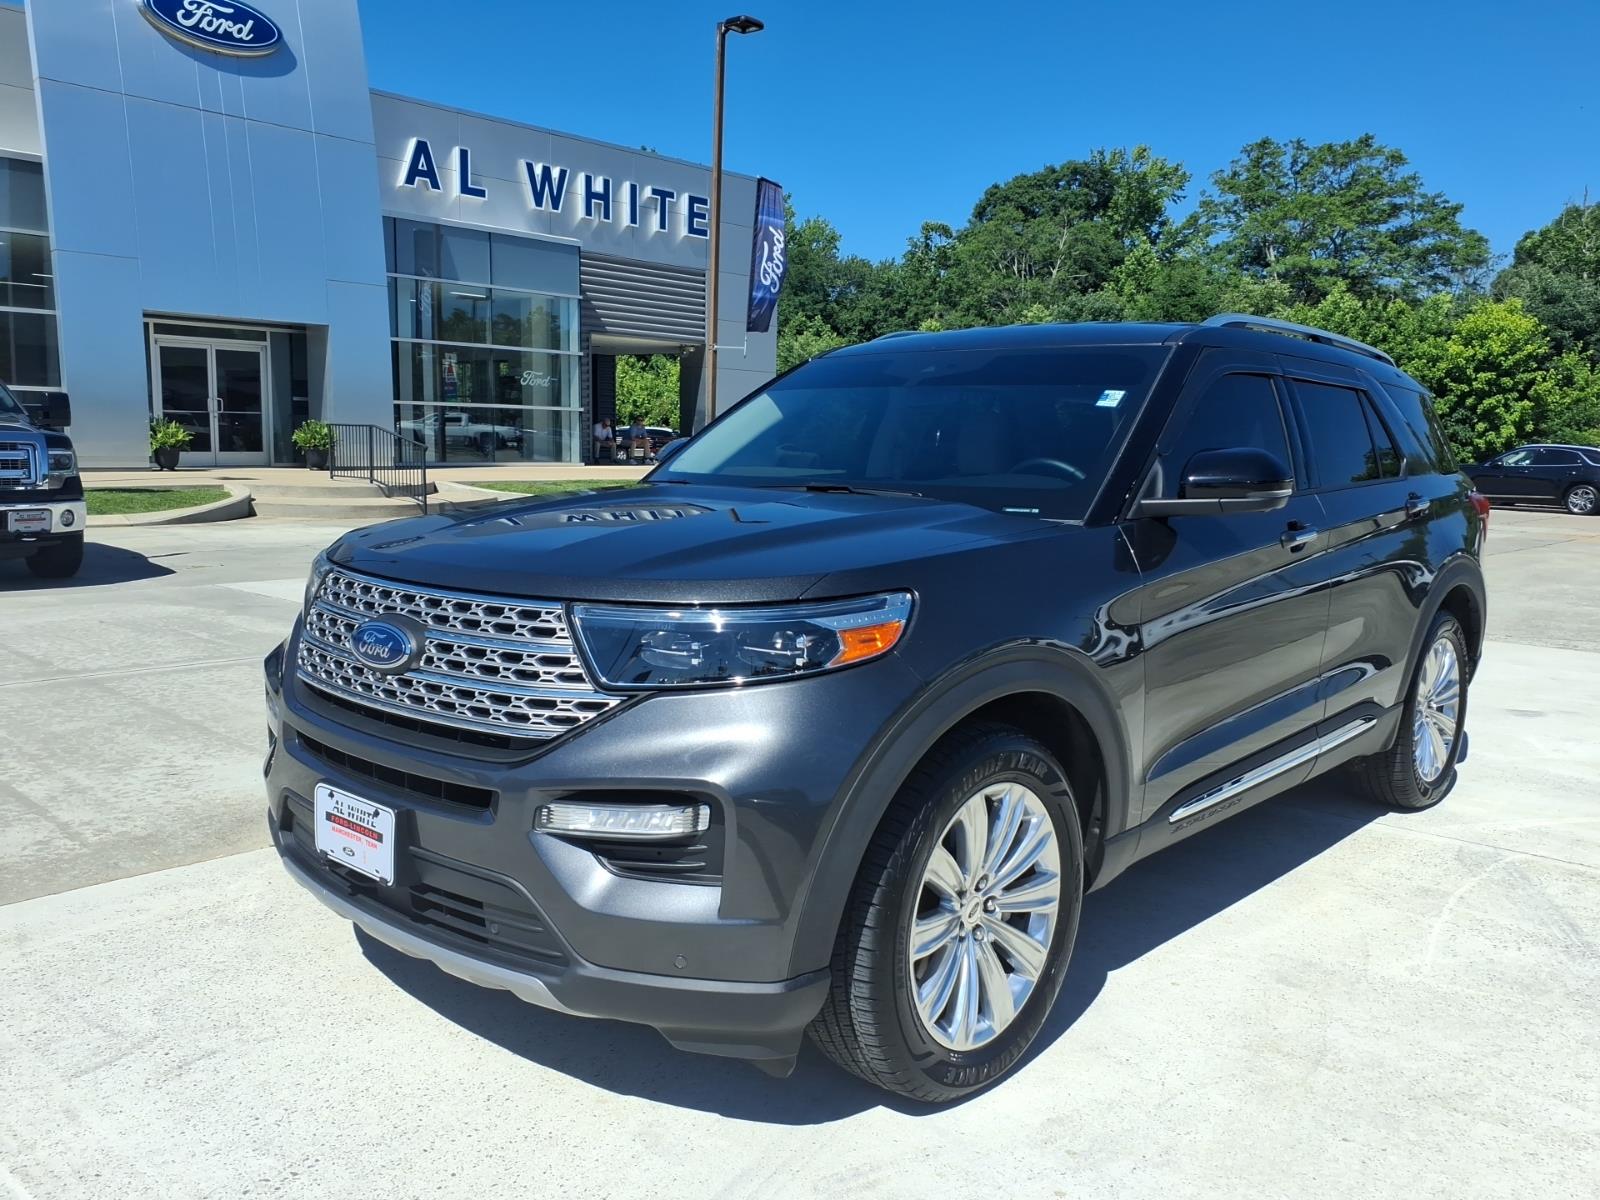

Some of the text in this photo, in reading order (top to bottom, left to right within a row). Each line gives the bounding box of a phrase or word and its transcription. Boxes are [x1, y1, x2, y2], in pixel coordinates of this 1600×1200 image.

[176, 0, 254, 40] Ford
[400, 137, 710, 239] AL WHITE
[760, 226, 784, 293] Ford
[520, 370, 551, 388] Ford
[359, 631, 393, 658] Ford
[333, 800, 345, 815] AL
